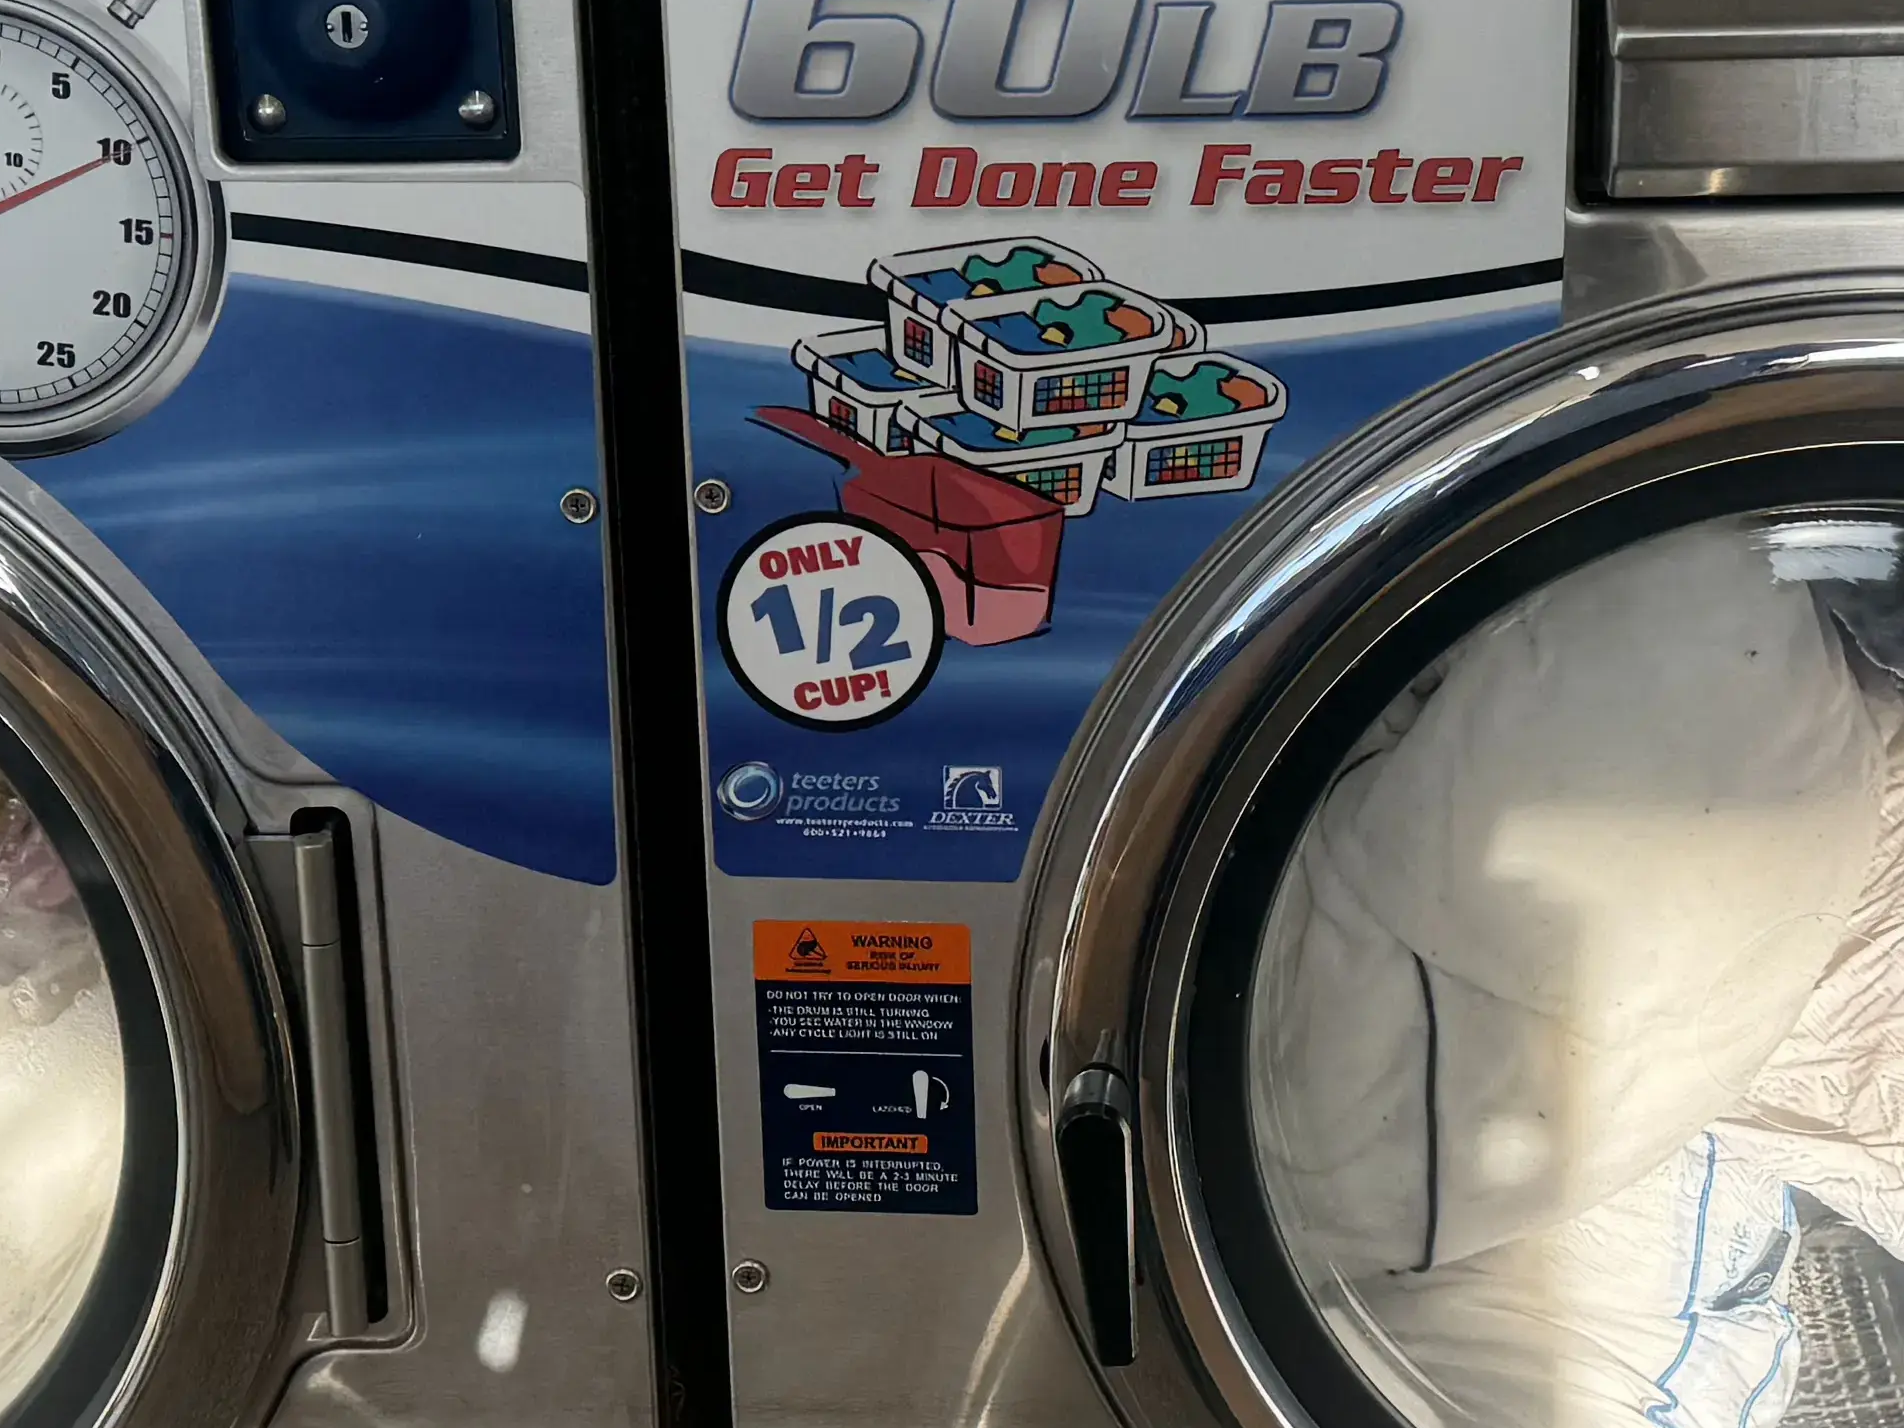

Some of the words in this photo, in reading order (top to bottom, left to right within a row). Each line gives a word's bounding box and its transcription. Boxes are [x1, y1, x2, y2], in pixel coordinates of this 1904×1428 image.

[52, 72, 70, 99] 5
[96, 137, 133, 166] 10
[710, 147, 880, 210] Get
[910, 145, 1158, 210] Done
[1190, 142, 1524, 208] Faster
[119, 219, 153, 245] 15
[93, 291, 131, 318] 20
[37, 341, 75, 368] 25
[759, 535, 864, 580] ONLY
[750, 583, 912, 670] 1/2
[794, 670, 892, 710] CUP!
[791, 771, 879, 791] teeters
[787, 792, 901, 816] products
[852, 935, 933, 950] WARNING
[821, 1136, 918, 1150] IMPORTANT
